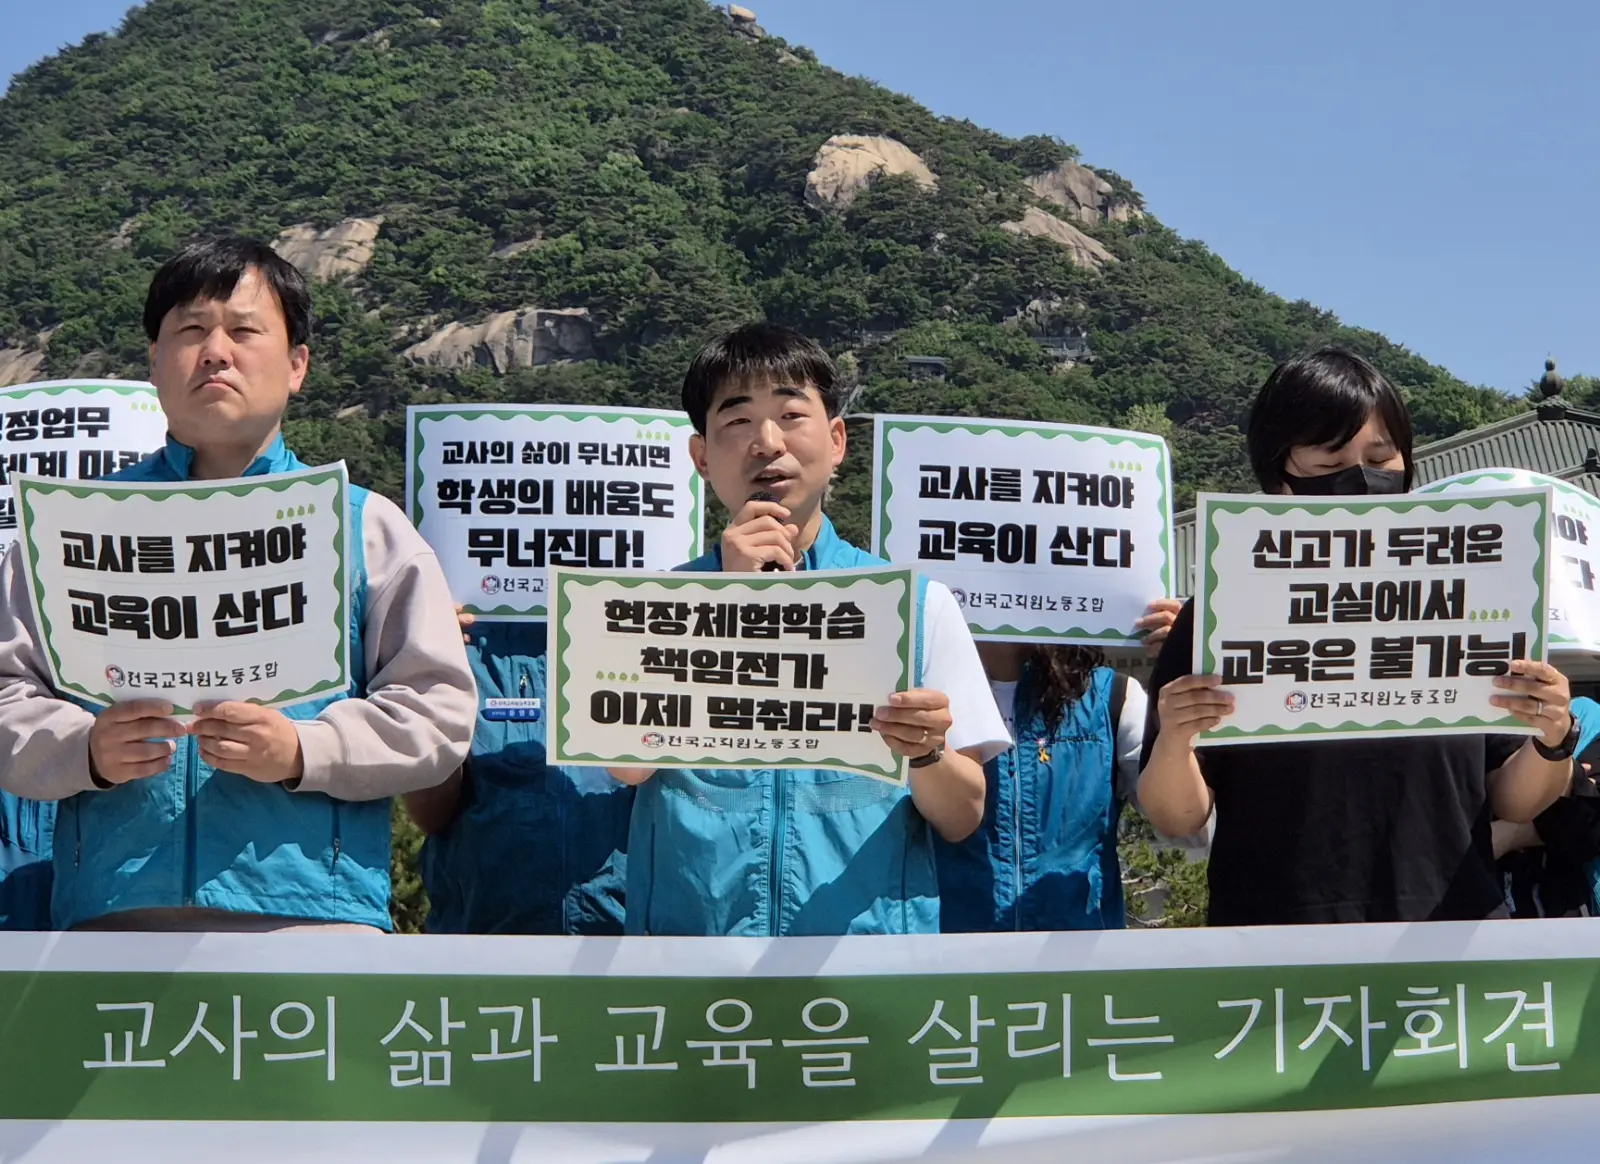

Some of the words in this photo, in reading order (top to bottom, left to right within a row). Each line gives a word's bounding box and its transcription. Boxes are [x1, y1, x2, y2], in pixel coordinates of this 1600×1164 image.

[0, 406, 111, 442] 정업무
[443, 441, 513, 464] 교사의
[522, 442, 569, 464] 삶이
[578, 443, 670, 468] 무너지면
[437, 479, 553, 514] 학생의
[566, 480, 673, 518] 배움도
[919, 465, 1021, 502] 교사를
[1033, 470, 1134, 508] 지켜야
[61, 531, 174, 573] 교사를
[186, 523, 306, 572] 지켜야
[465, 526, 646, 570] 무너진다!
[918, 520, 1036, 564] 교육이
[1049, 526, 1134, 568] 산다
[1252, 530, 1375, 568] 신고가
[1388, 524, 1502, 565] 두려운
[503, 577, 548, 593] 전국교
[970, 593, 1103, 612] 전국교직원노동조합
[1288, 579, 1465, 624] 교실에서
[68, 589, 198, 639] 교육이
[213, 582, 307, 637] 산다
[605, 600, 864, 639] 현장체험학습
[128, 662, 277, 688] 전국교직원노동조합
[641, 647, 828, 689] 책임전가
[1220, 639, 1355, 685] 교육은
[1368, 631, 1526, 677] 불가능!
[591, 691, 691, 727] 이제
[706, 696, 876, 733] 멈춰라!
[1311, 689, 1457, 708] 전국교직원노동조합
[669, 736, 819, 749] 전국교직원노동조합
[84, 996, 335, 1080] 교사의
[380, 998, 557, 1087] 삶과
[596, 999, 869, 1088] 교육을
[909, 994, 1174, 1084] 살리는
[1215, 982, 1560, 1073] 기자회견
